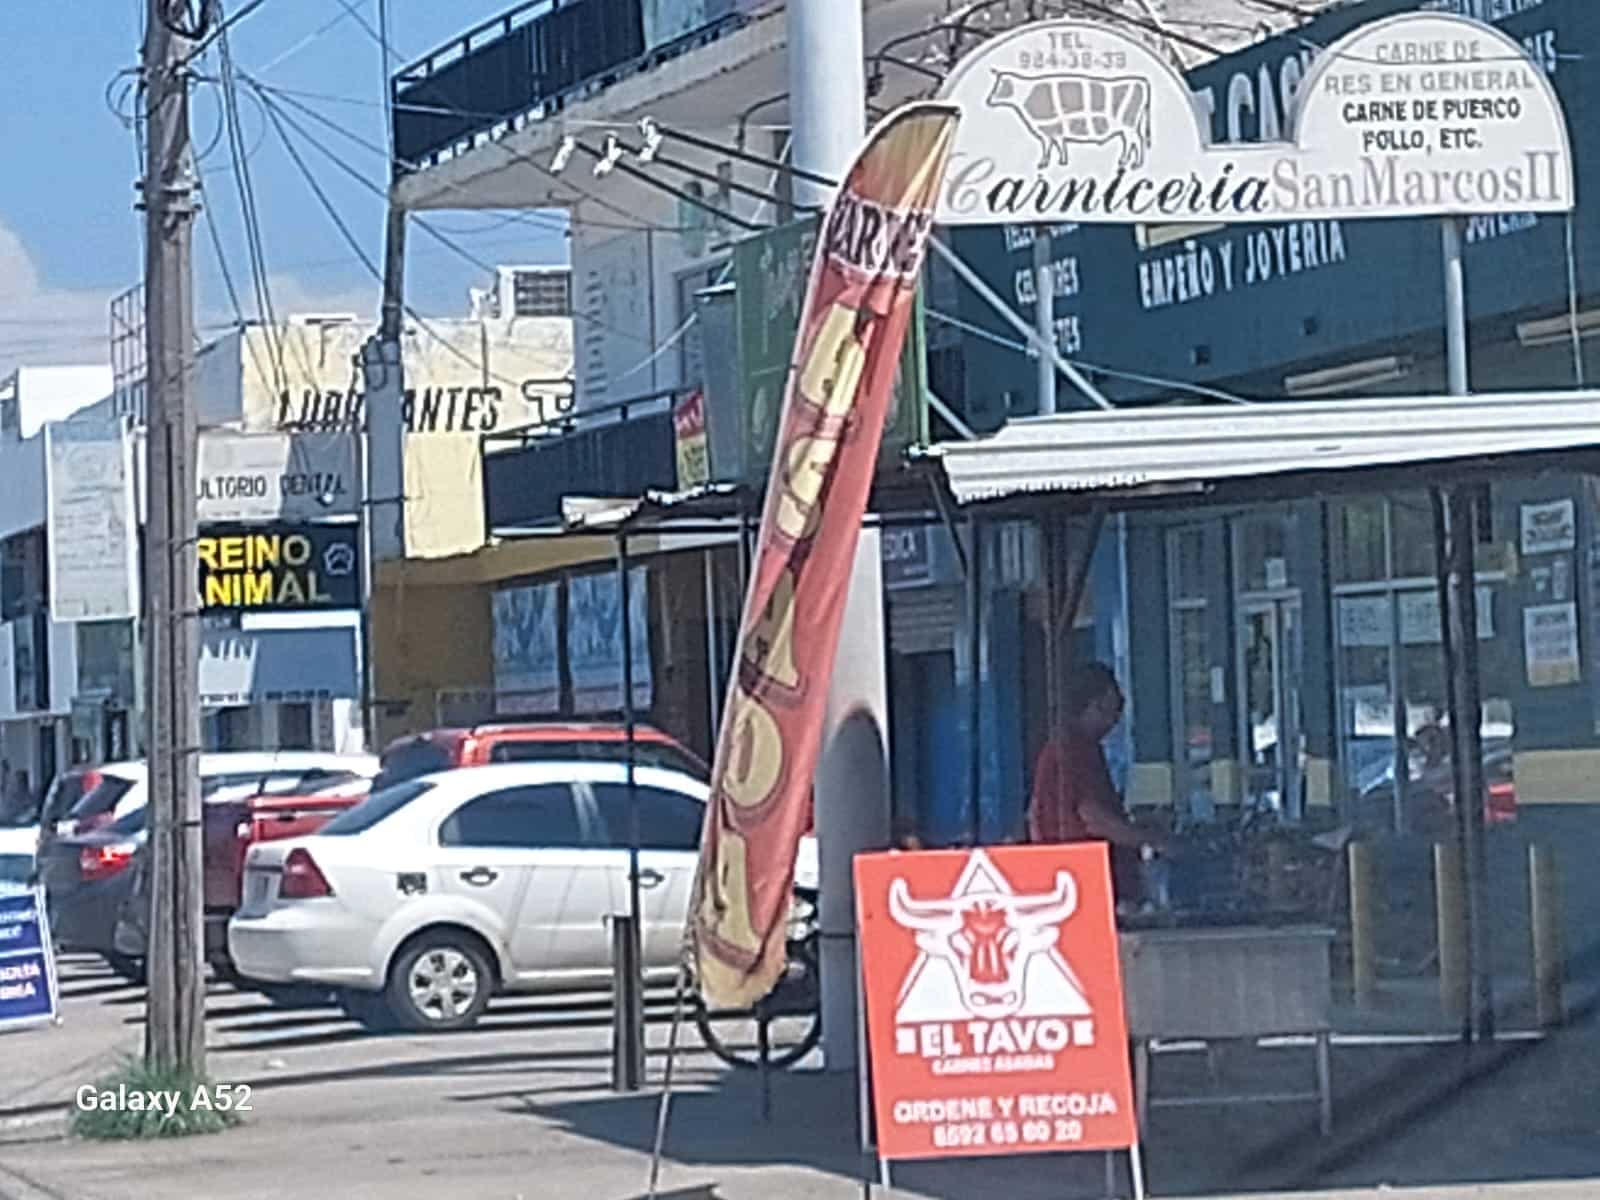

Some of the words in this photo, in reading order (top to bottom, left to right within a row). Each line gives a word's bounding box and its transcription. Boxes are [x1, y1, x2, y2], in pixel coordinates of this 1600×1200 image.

[1375, 42, 1444, 62] CARNE
[1452, 40, 1481, 60] DE
[1323, 73, 1372, 95] RES
[1380, 72, 1412, 93] EN
[1419, 69, 1536, 92] GENERAL
[1342, 100, 1407, 123] CARNE
[1412, 99, 1440, 121] DE
[1443, 96, 1522, 120] PUERCO
[1439, 128, 1483, 149] ETC.
[1139, 240, 1214, 308] EMPEÑO
[1220, 240, 1233, 291] Y
[197, 535, 311, 570] REINO
[920, 1021, 962, 1057] EL
[968, 1019, 1068, 1054] TAVO
[894, 1100, 992, 1123] ORDENE
[997, 1098, 1014, 1117] Y
[1018, 1092, 1117, 1116] RECOJA
